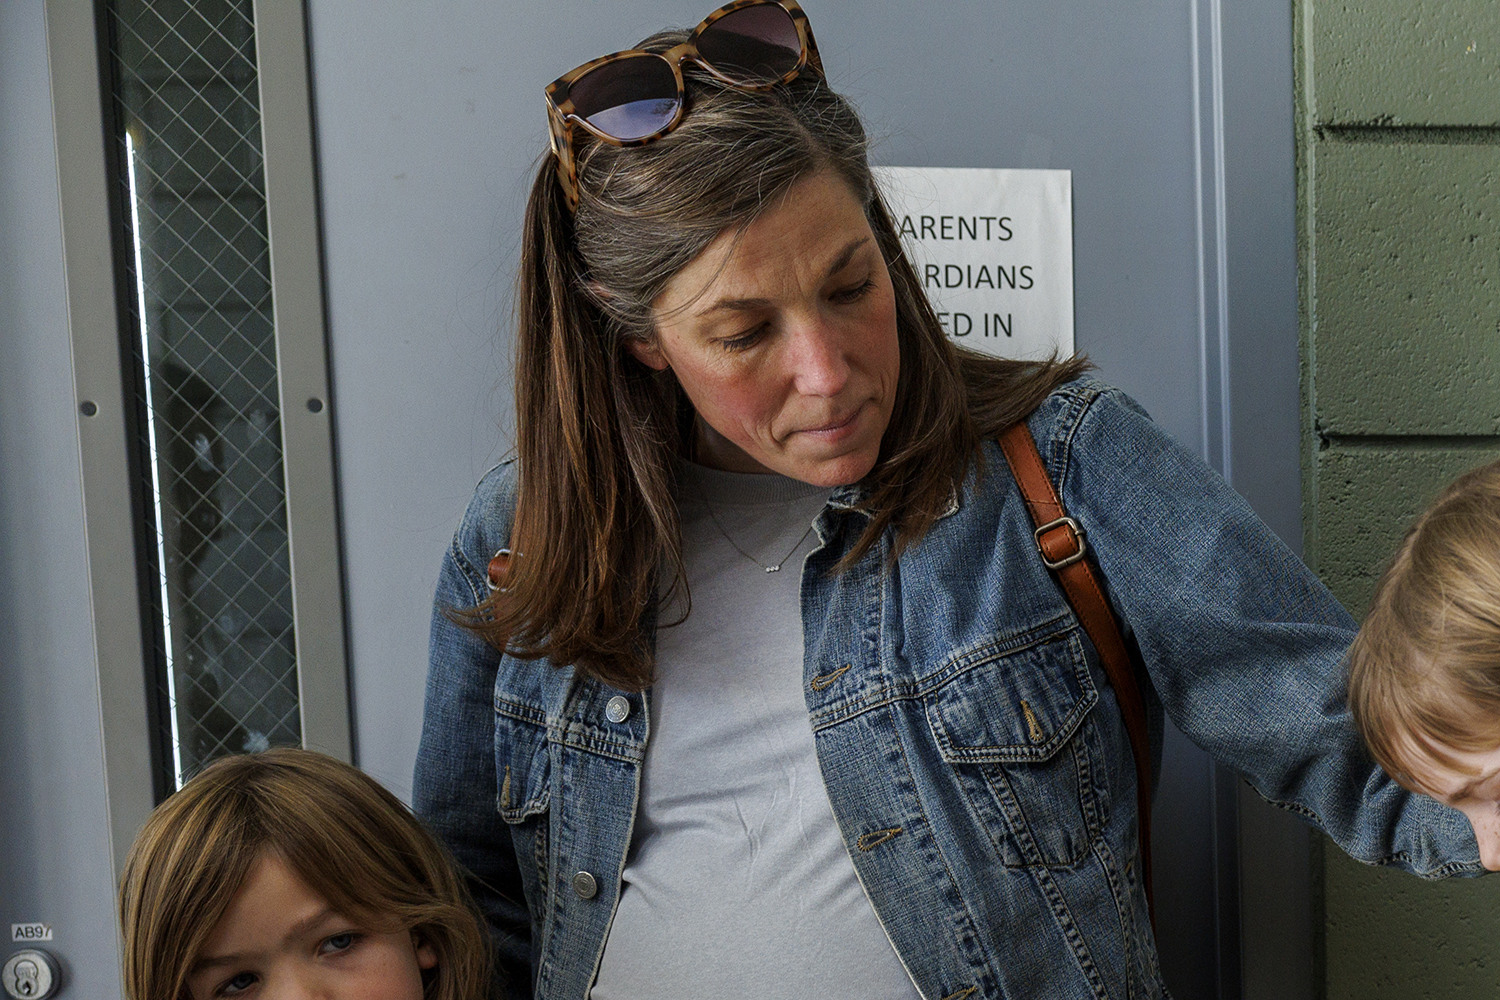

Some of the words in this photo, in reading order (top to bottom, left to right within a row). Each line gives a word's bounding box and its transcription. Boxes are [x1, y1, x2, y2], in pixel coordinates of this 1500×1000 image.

[892, 214, 1014, 242] ARENTS
[921, 263, 1034, 290] RDIANS
[983, 312, 1013, 338] IN
